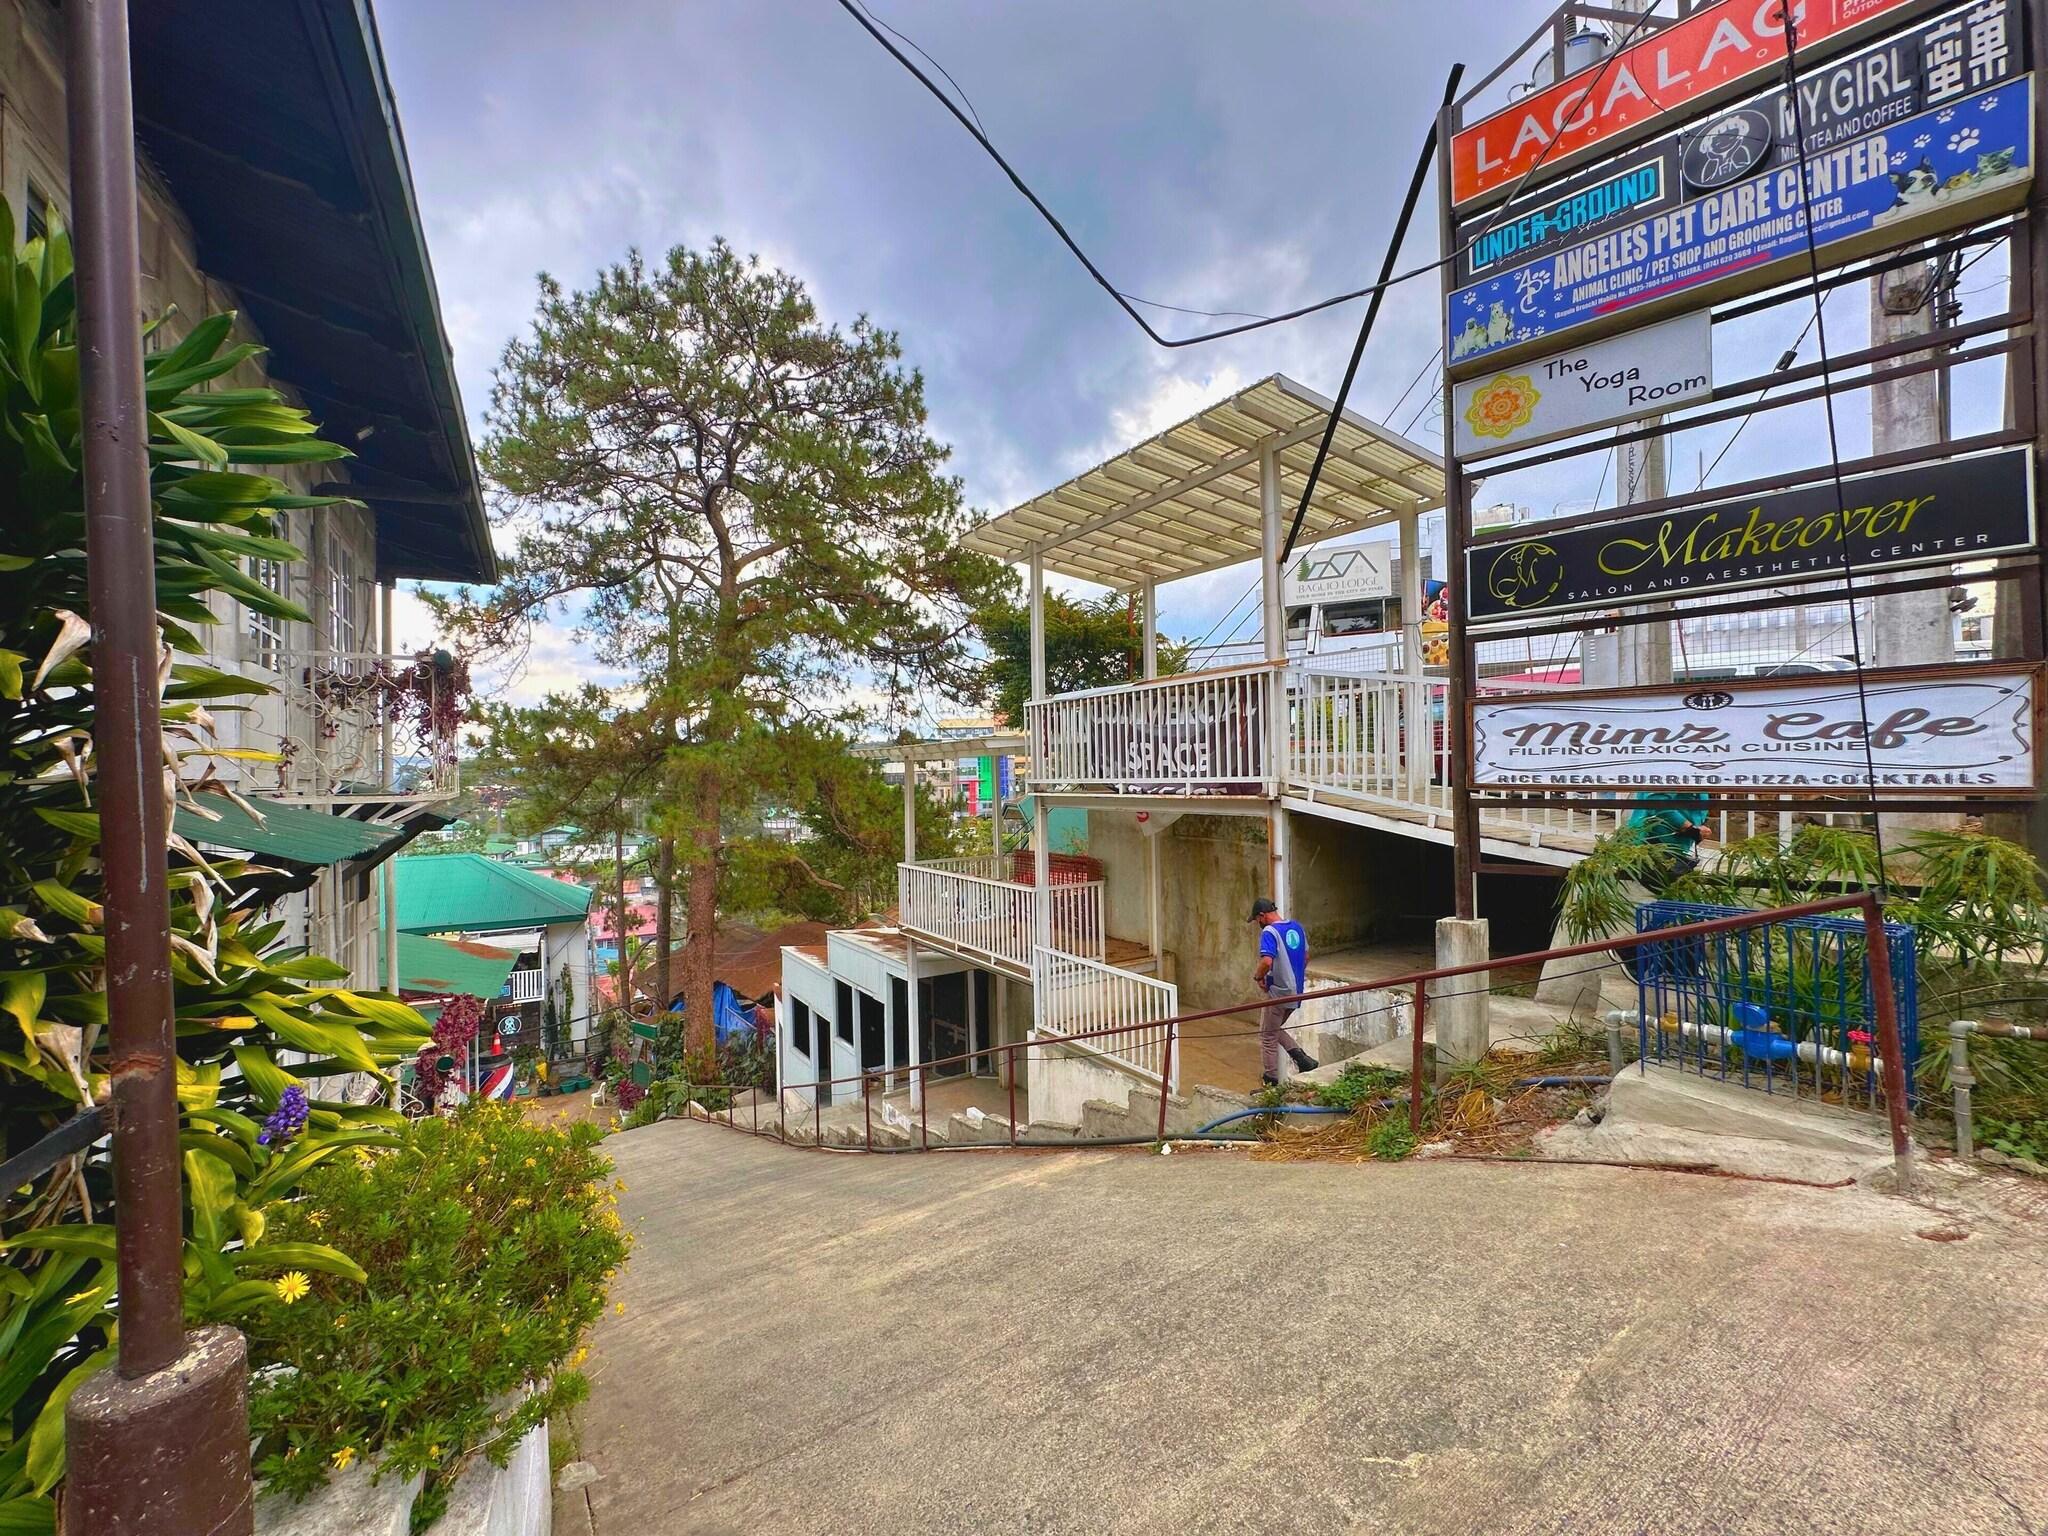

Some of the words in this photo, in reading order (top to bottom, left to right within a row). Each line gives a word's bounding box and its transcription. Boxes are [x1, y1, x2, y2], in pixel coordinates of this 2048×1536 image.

[1810, 128, 1833, 152] TEA
[1836, 117, 1860, 143] AND
[1863, 96, 1911, 130] COFFEE
[1553, 223, 1649, 290] ANGELES
[1653, 204, 1697, 254] PET
[1703, 177, 1771, 237] CARE
[1777, 135, 1888, 210] CENTER
[1572, 278, 1609, 304] ANIMAL
[1610, 264, 1642, 294] CLINIC
[1645, 262, 1650, 280] /
[1652, 256, 1671, 277] PET
[1672, 246, 1702, 270] SHOP
[1703, 235, 1727, 259] AND
[1728, 213, 1793, 252] GROOMING
[1544, 358, 1589, 379] The
[1579, 367, 1640, 393] Yoga
[1628, 375, 1707, 406] Room
[1597, 494, 1936, 576] Makeover
[1568, 584, 1633, 600] SALON
[1647, 575, 1690, 589] AND
[1706, 553, 1850, 580] AESTHETIC
[1870, 534, 1989, 558] CENTER
[1298, 580, 1340, 594] BAGUIO
[1342, 576, 1379, 588] LODGE
[1502, 721, 1731, 748] Mimz
[1763, 707, 1989, 750] Cafe
[1128, 741, 1208, 773] SPACE
[1610, 743, 1731, 755] MEXICAN
[1741, 741, 1867, 753] CUISINE
[1497, 774, 1542, 785] RICE
